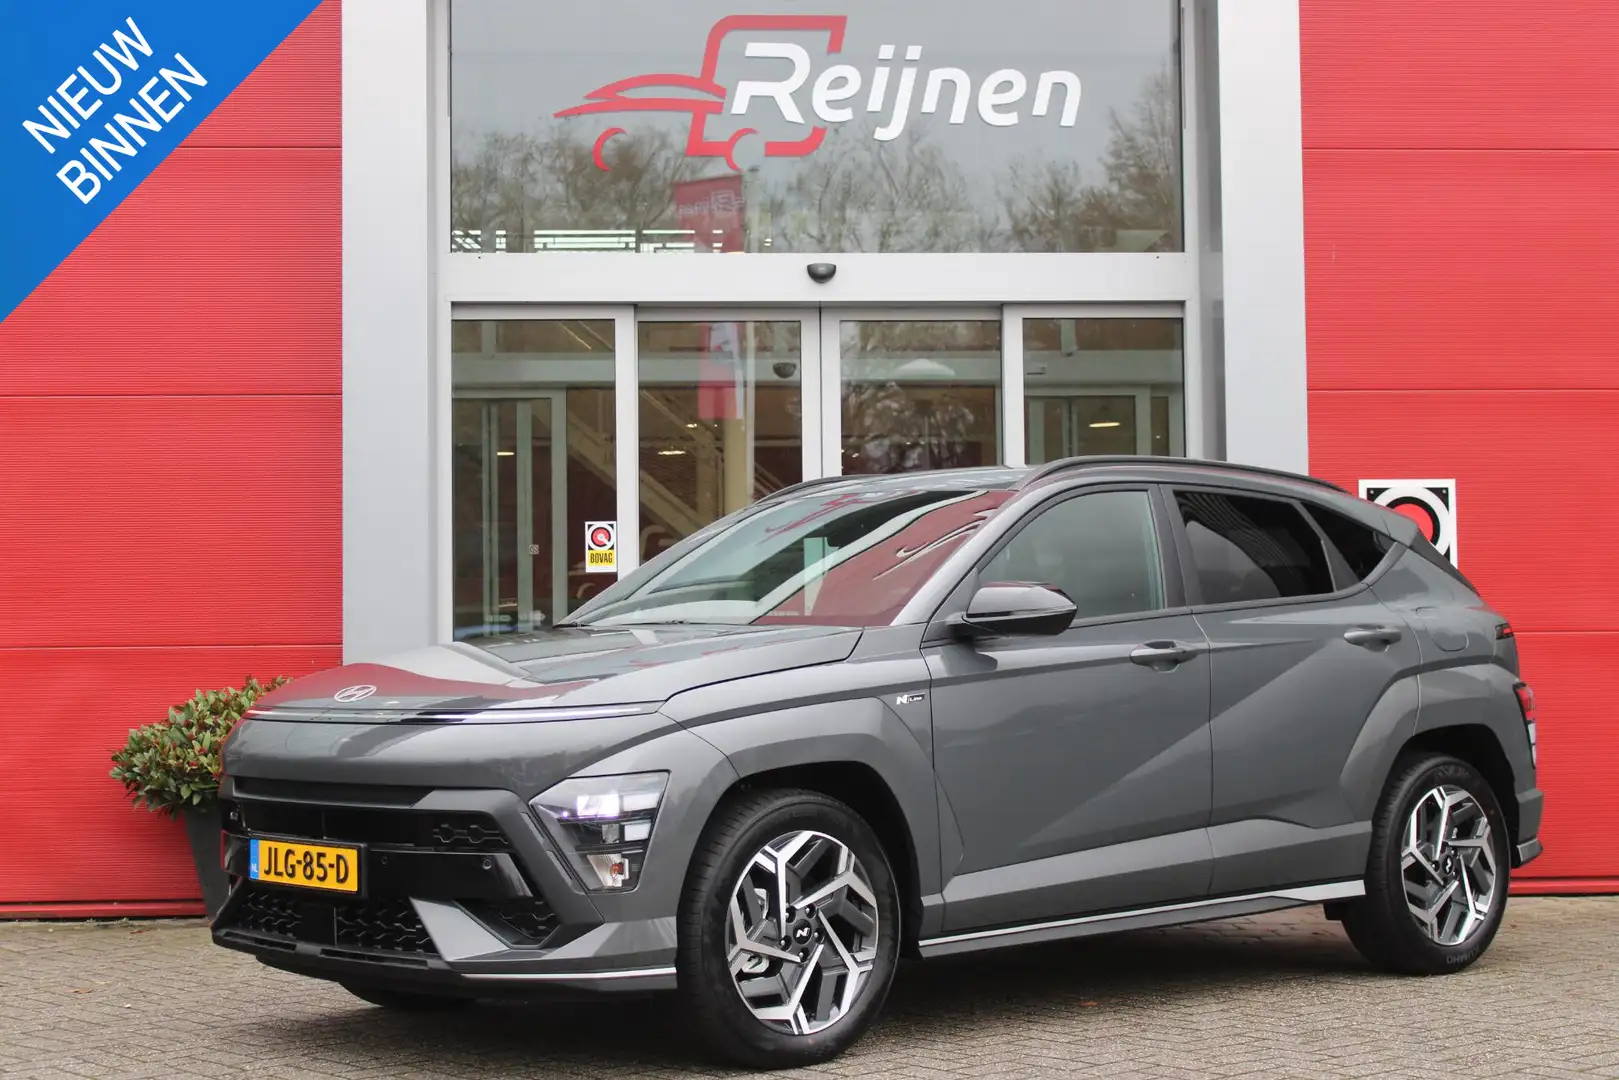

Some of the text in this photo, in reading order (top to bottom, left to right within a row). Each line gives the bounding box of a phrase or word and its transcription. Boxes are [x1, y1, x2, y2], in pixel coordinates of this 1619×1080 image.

[731, 42, 1082, 141] Reijnen
[590, 552, 613, 564] BOVAG
[251, 846, 349, 884] NL JLG-85-D
